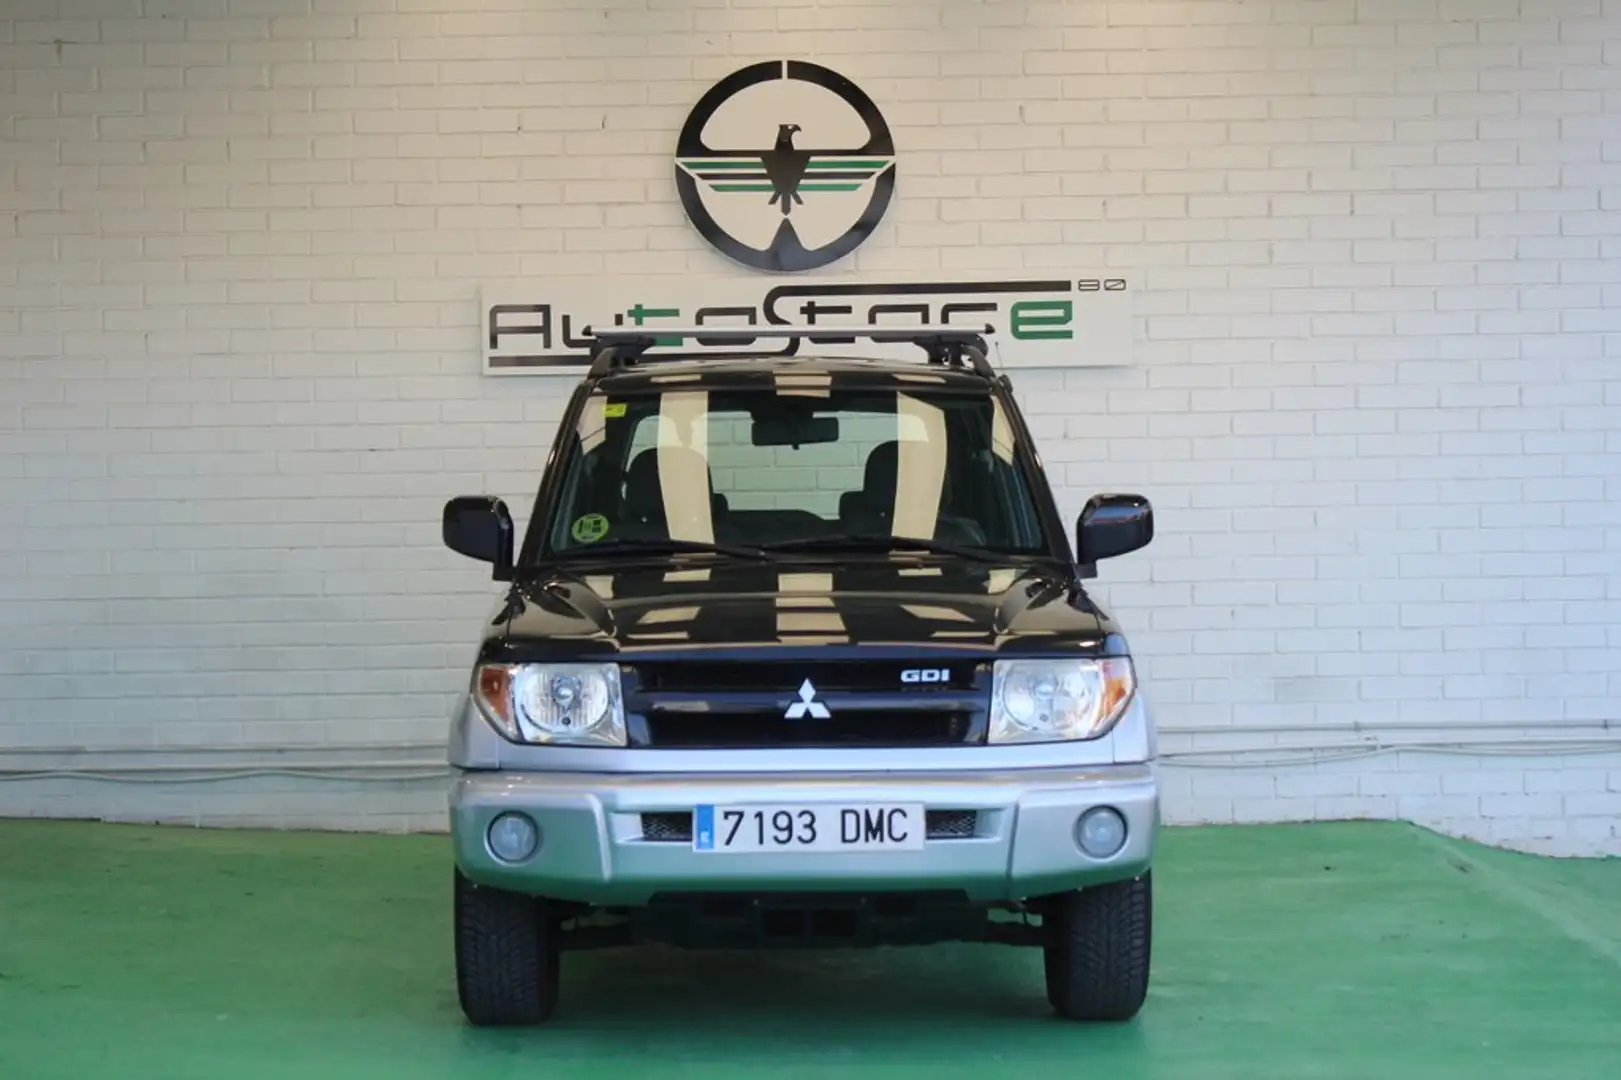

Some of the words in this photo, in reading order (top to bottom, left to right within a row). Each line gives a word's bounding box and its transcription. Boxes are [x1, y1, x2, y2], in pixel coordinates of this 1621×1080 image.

[1078, 279, 1126, 291] 80
[901, 669, 950, 682] GDI
[723, 810, 817, 846] 7193
[840, 808, 908, 844] DMC
